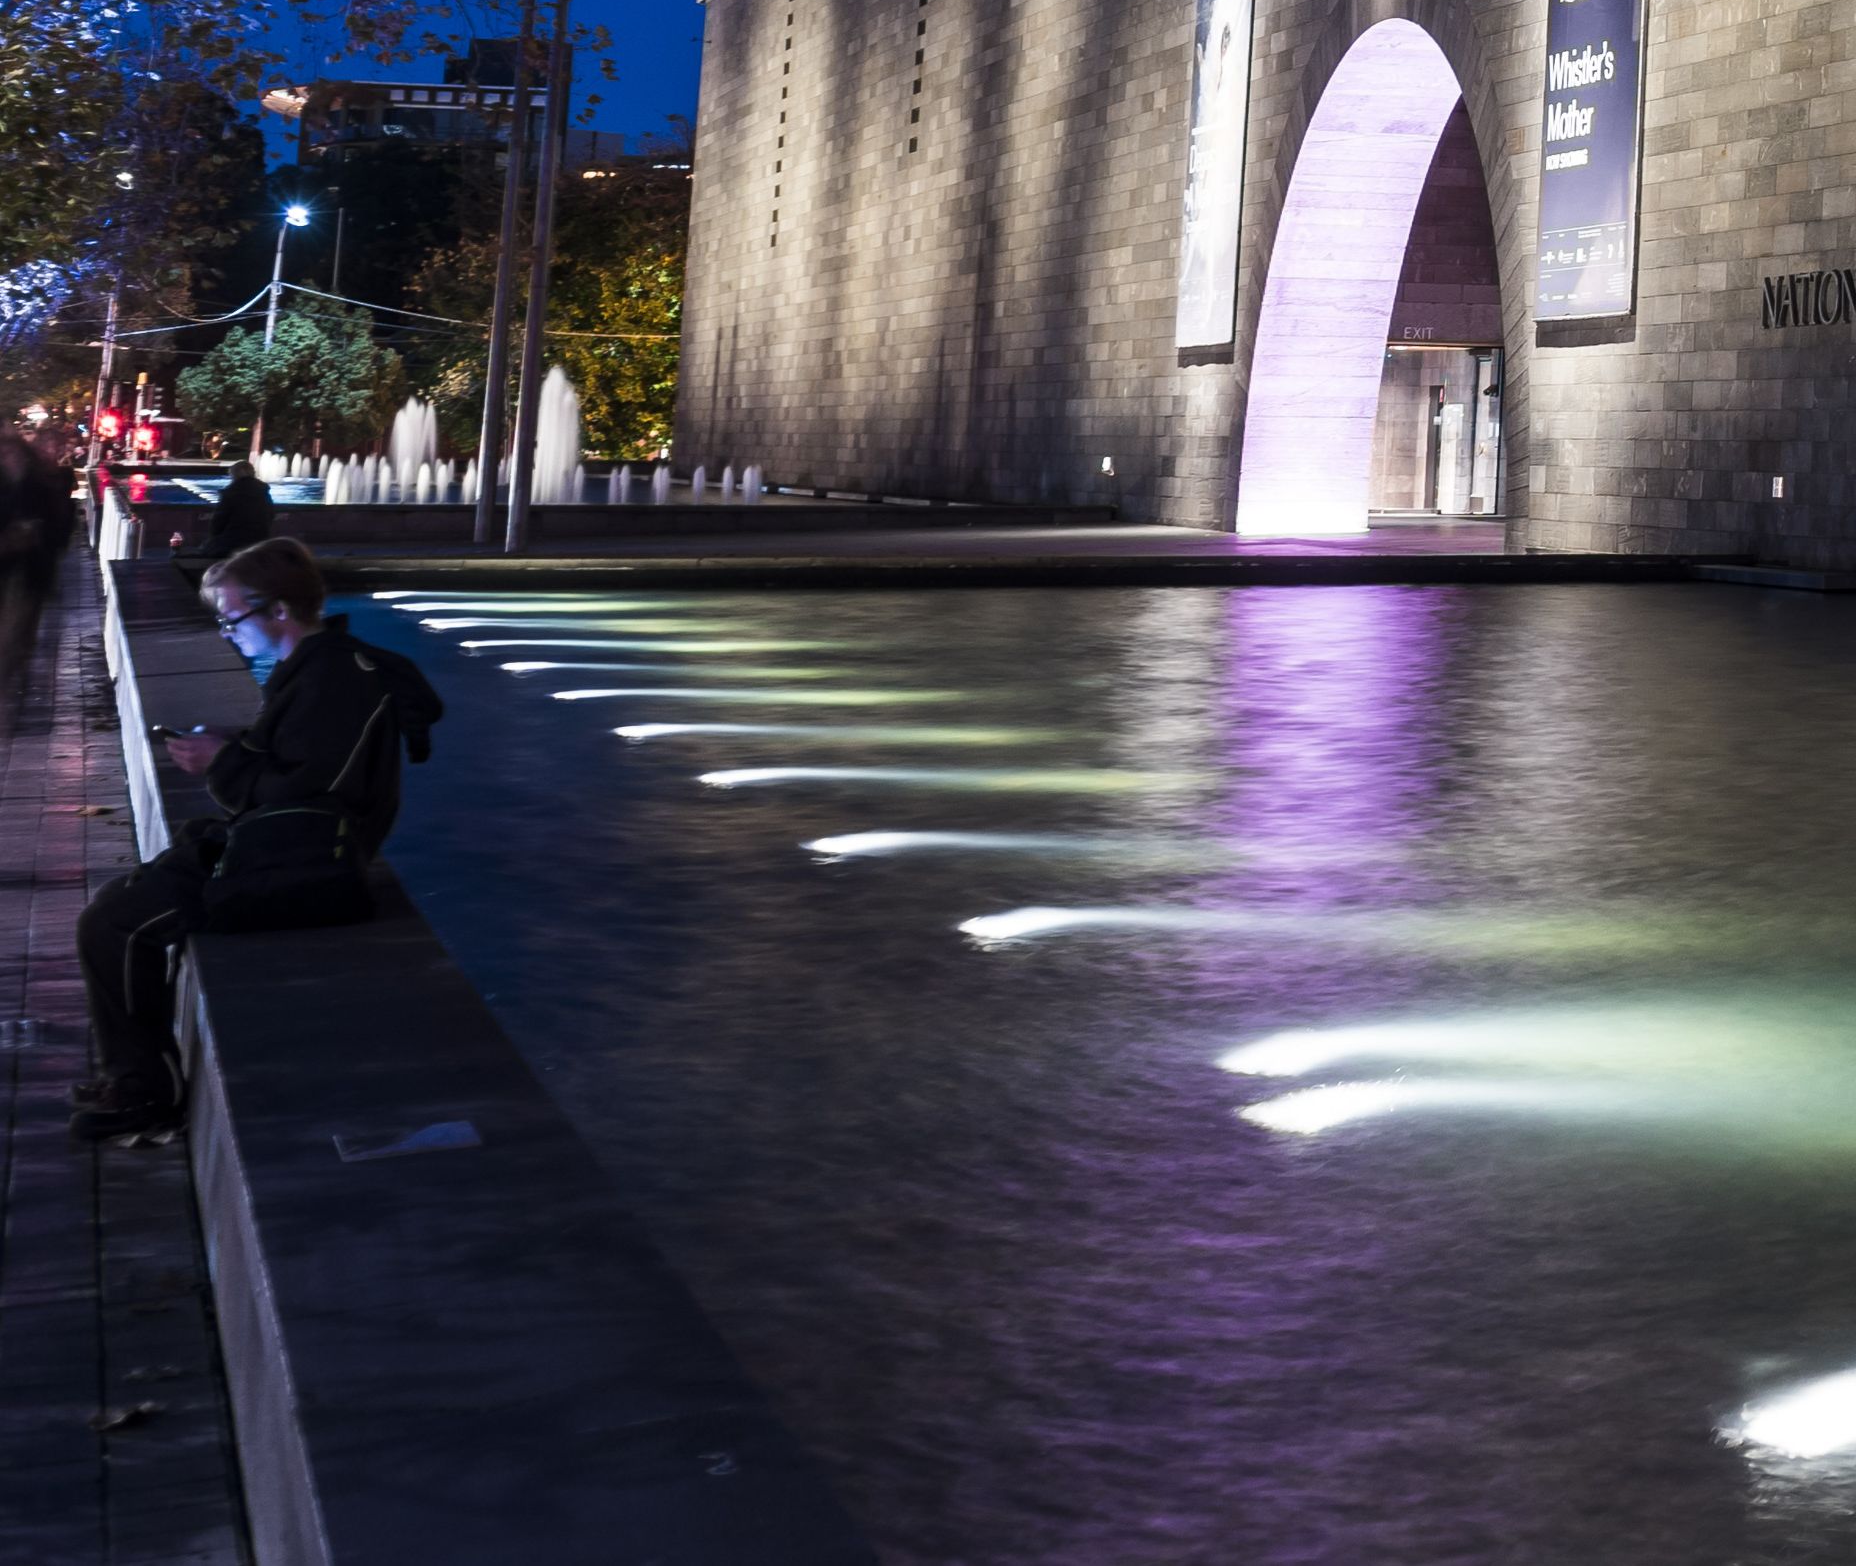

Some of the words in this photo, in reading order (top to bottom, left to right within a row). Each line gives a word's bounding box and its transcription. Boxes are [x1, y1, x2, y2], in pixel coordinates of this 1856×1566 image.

[1549, 40, 1614, 92] Whistler's
[1546, 98, 1595, 142] Mother
[1403, 326, 1435, 340] EXIT
